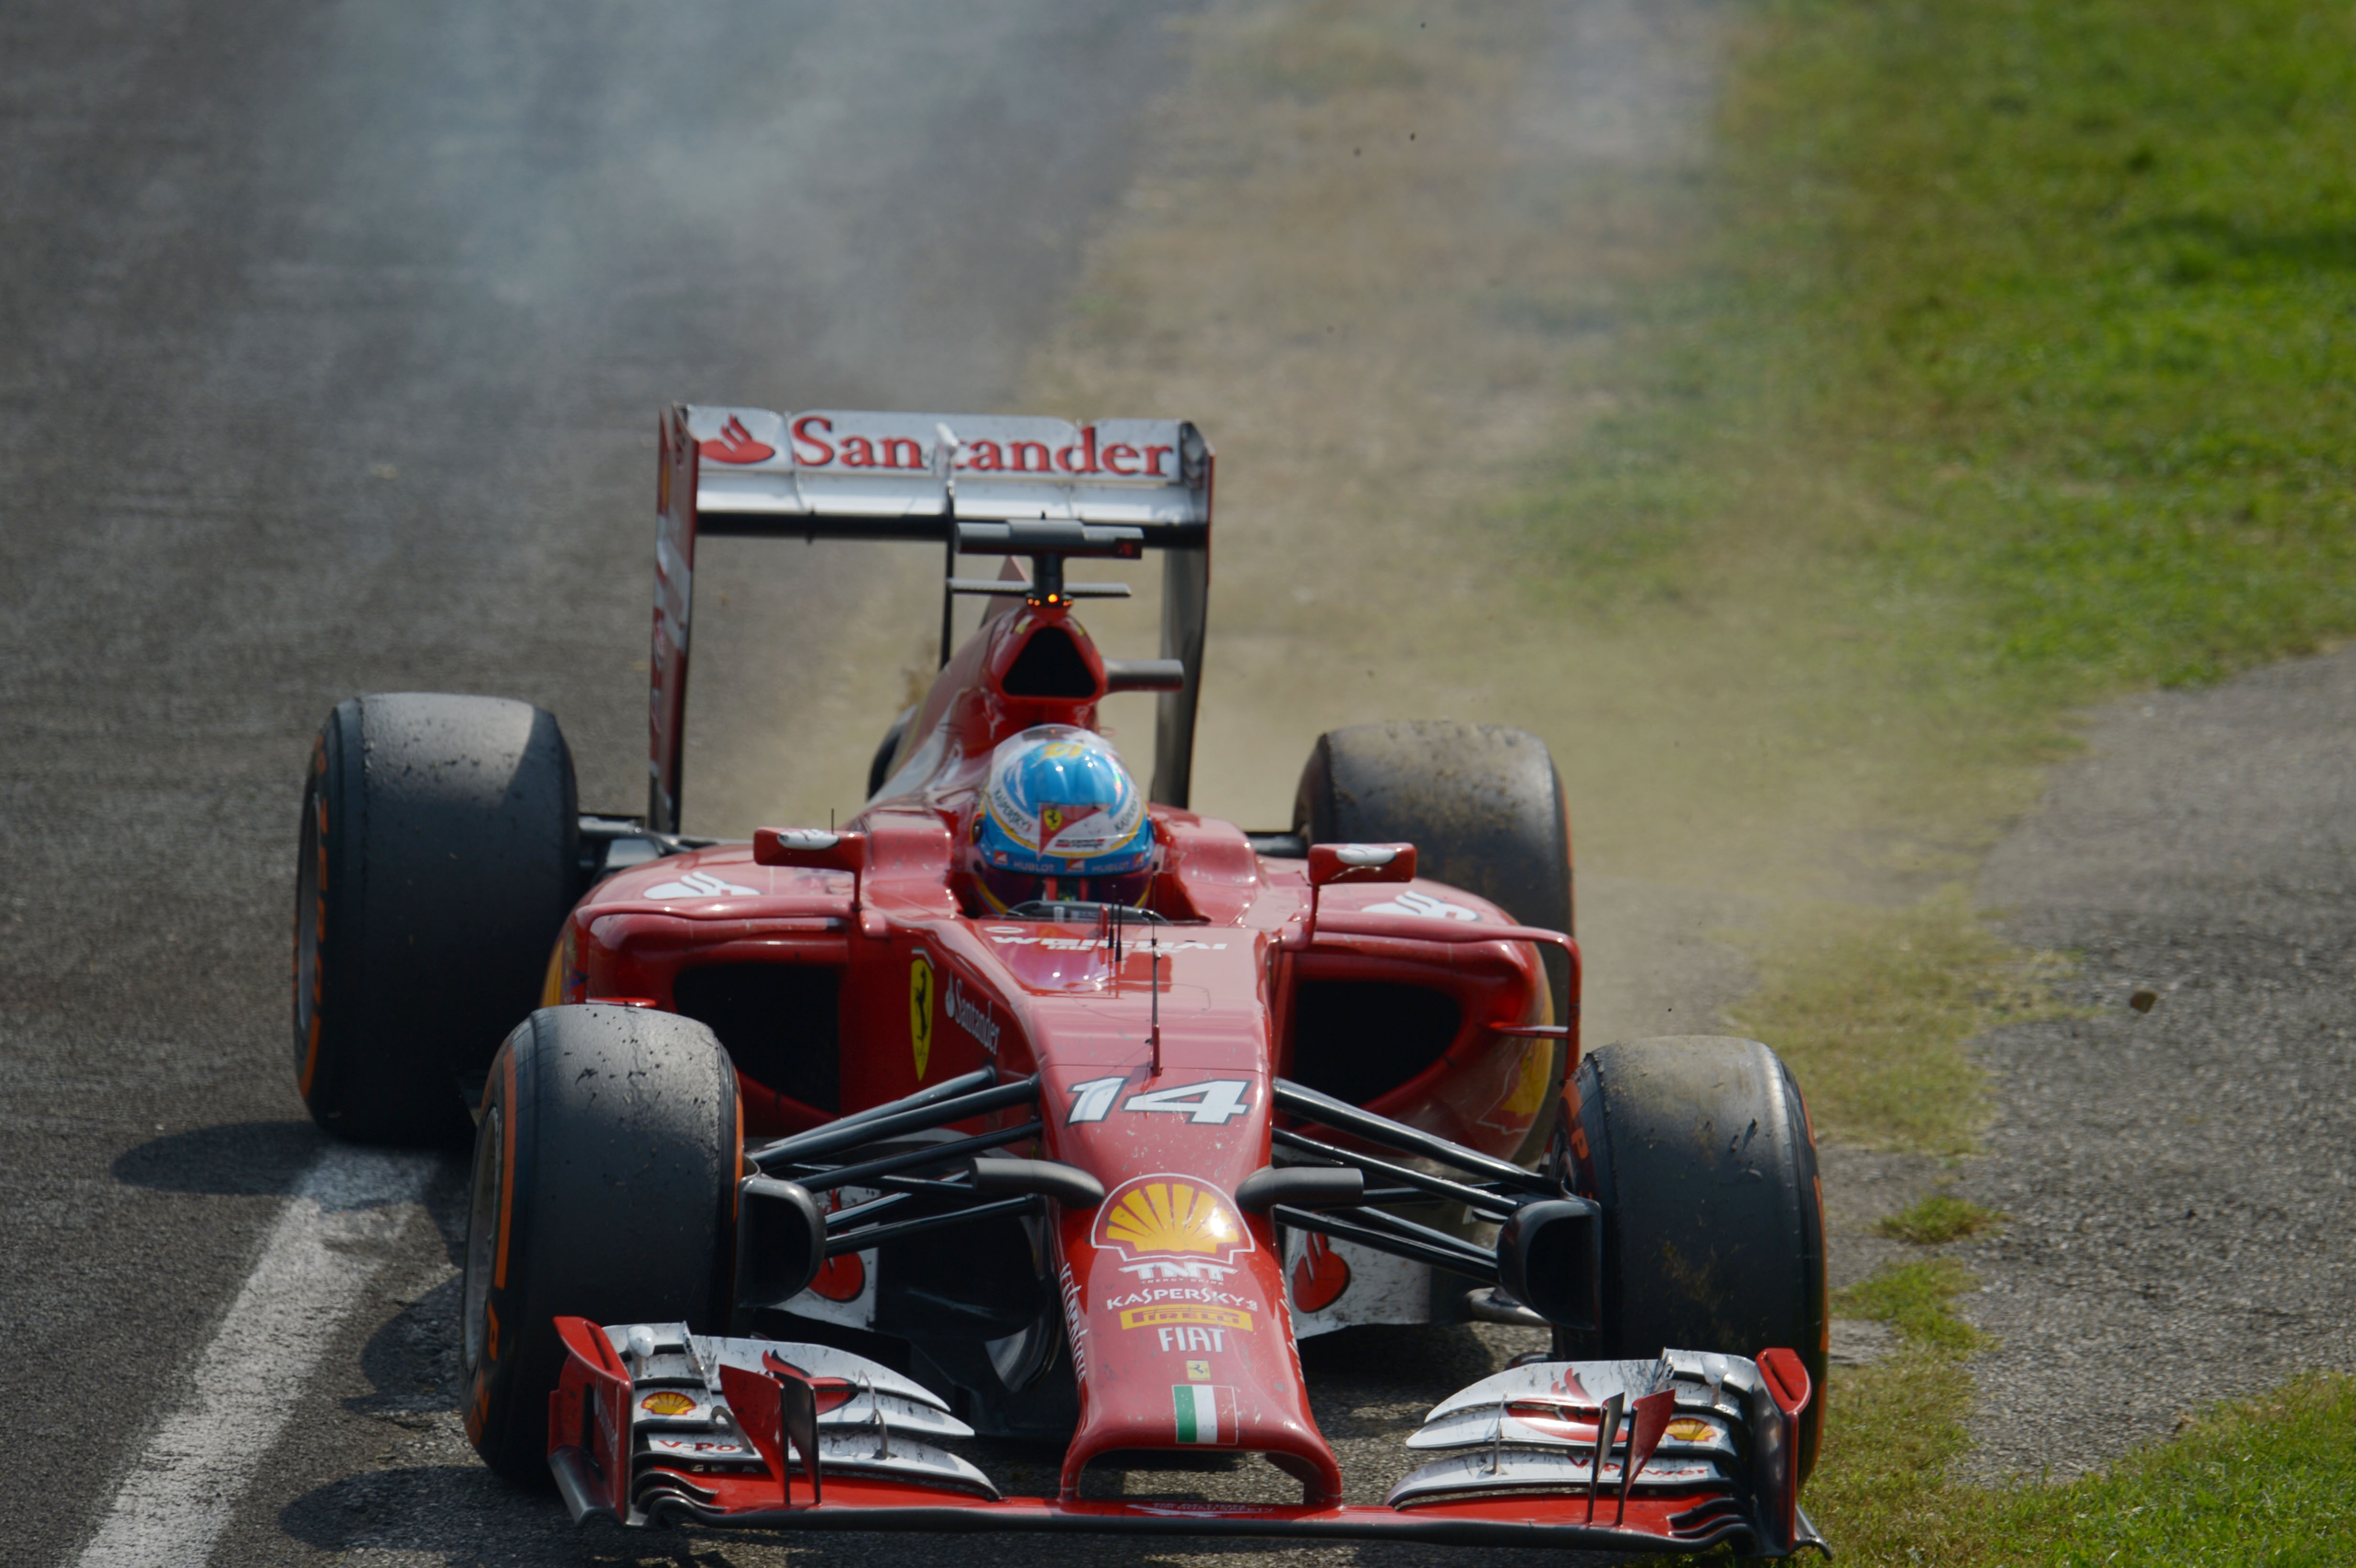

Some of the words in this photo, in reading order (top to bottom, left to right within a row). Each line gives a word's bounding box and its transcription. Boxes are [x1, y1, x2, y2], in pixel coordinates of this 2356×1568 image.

[792, 416, 1173, 476] Sanander
[1067, 1077, 1252, 1126] 14
[1119, 1261, 1238, 1281] TNT
[1106, 1287, 1245, 1310] KASPERSKY
[1131, 1307, 1240, 1324] PIRELLI
[1157, 1327, 1225, 1353] FIAT
